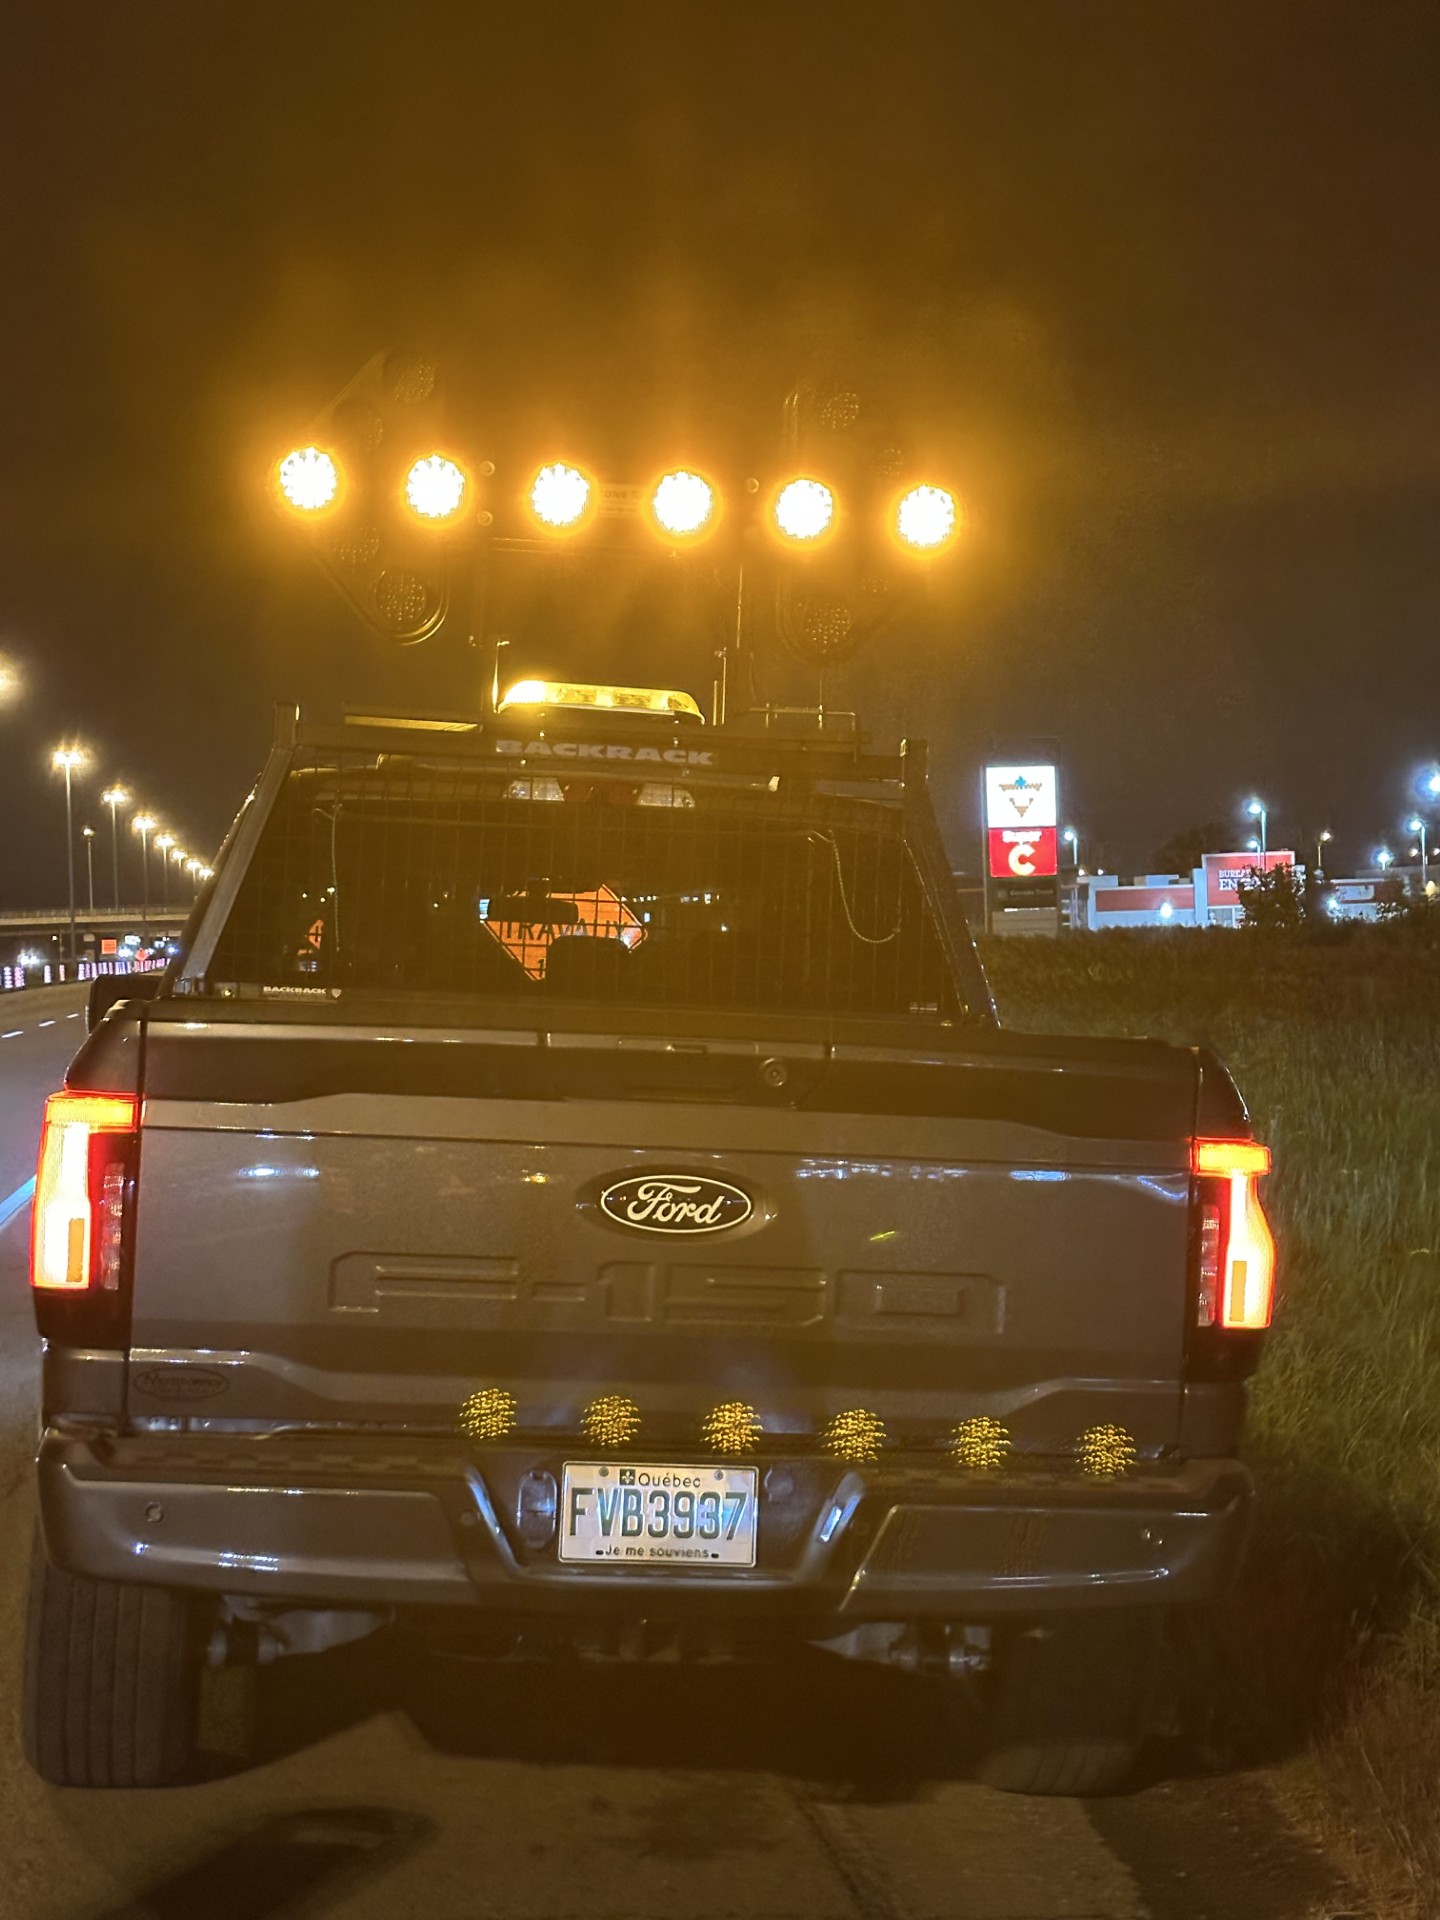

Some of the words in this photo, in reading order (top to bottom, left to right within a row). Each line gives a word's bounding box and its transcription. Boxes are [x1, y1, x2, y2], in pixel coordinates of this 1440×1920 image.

[495, 739, 714, 766] BACKRACK
[1008, 844, 1036, 876] C
[263, 986, 327, 994] BACKRACK
[627, 1182, 725, 1224] Ford
[328, 1251, 1007, 1334] F-150
[638, 1471, 702, 1488] Québec
[568, 1487, 748, 1541] FVB3937
[605, 1544, 620, 1556] Je
[626, 1546, 645, 1557] me
[649, 1545, 710, 1558] souviens
